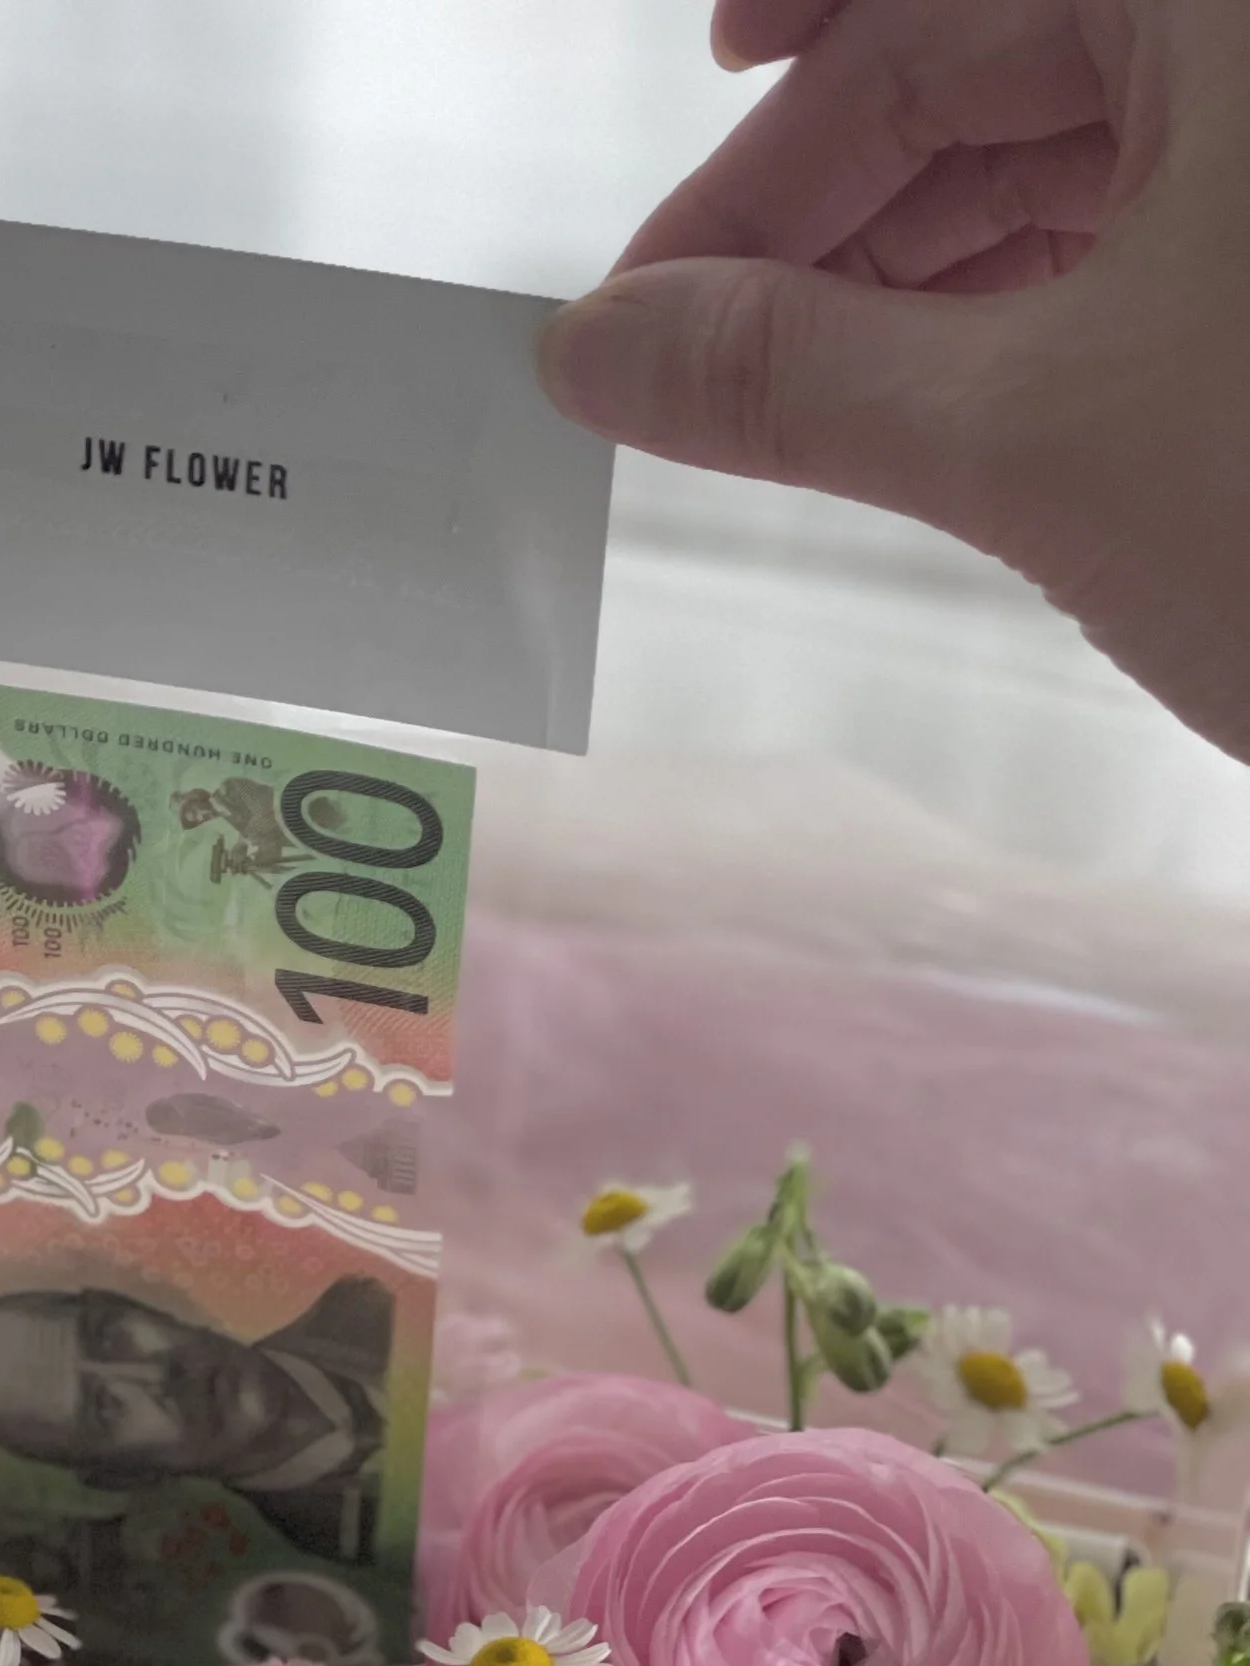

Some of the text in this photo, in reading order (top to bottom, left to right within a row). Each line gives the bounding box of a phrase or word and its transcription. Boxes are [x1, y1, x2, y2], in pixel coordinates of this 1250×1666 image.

[80, 436, 288, 500] JW FLOWER
[13, 718, 273, 770] ONE HUNDRED DOLLARS
[273, 768, 444, 1025] 100
[11, 916, 30, 946] 100
[44, 927, 62, 958] 100
